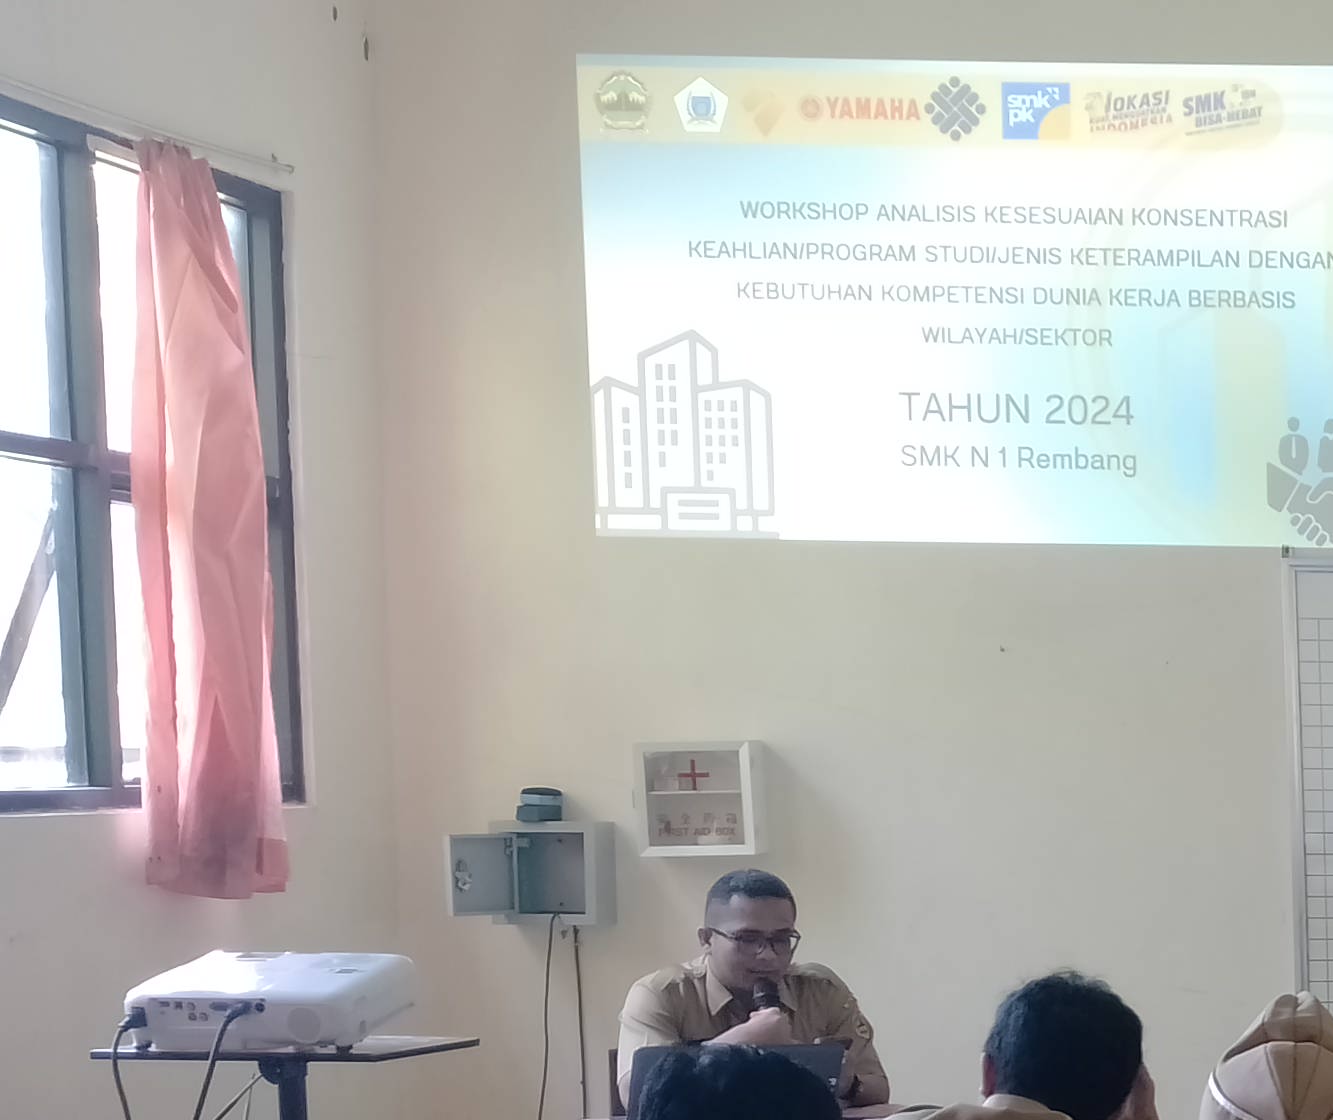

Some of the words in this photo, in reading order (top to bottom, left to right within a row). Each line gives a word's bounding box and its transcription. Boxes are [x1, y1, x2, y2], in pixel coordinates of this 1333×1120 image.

[826, 96, 921, 121] YAMAHA
[1007, 90, 1051, 109] smk
[1182, 90, 1226, 117] SMK
[1008, 106, 1036, 127] pk
[739, 200, 869, 222] WORKSHOP
[876, 203, 977, 224] ANALISIS
[984, 205, 1125, 227] KESESUAIAN
[1131, 207, 1289, 229] KONSENTRASI
[688, 239, 917, 263] KEAHLIAN/PROGRAM
[924, 244, 1063, 266] STUDI/JENIS
[1070, 247, 1241, 269] KETERAMPILAN
[736, 281, 873, 302] KEBUTUHAN
[881, 284, 1025, 305] KOMPETENSI
[1032, 286, 1103, 307] DUNIA
[1108, 287, 1182, 308] KERJA
[1188, 288, 1297, 310] BERBASIS
[921, 325, 1113, 348] WILAYAH/SEKTOR
[897, 391, 1030, 425] TAHUN
[1044, 393, 1135, 426] 2024
[900, 444, 961, 468] SMK
[970, 445, 990, 469] N
[997, 445, 1007, 469] 1
[1017, 445, 1137, 479] Rembang
[658, 827, 689, 837] FRST
